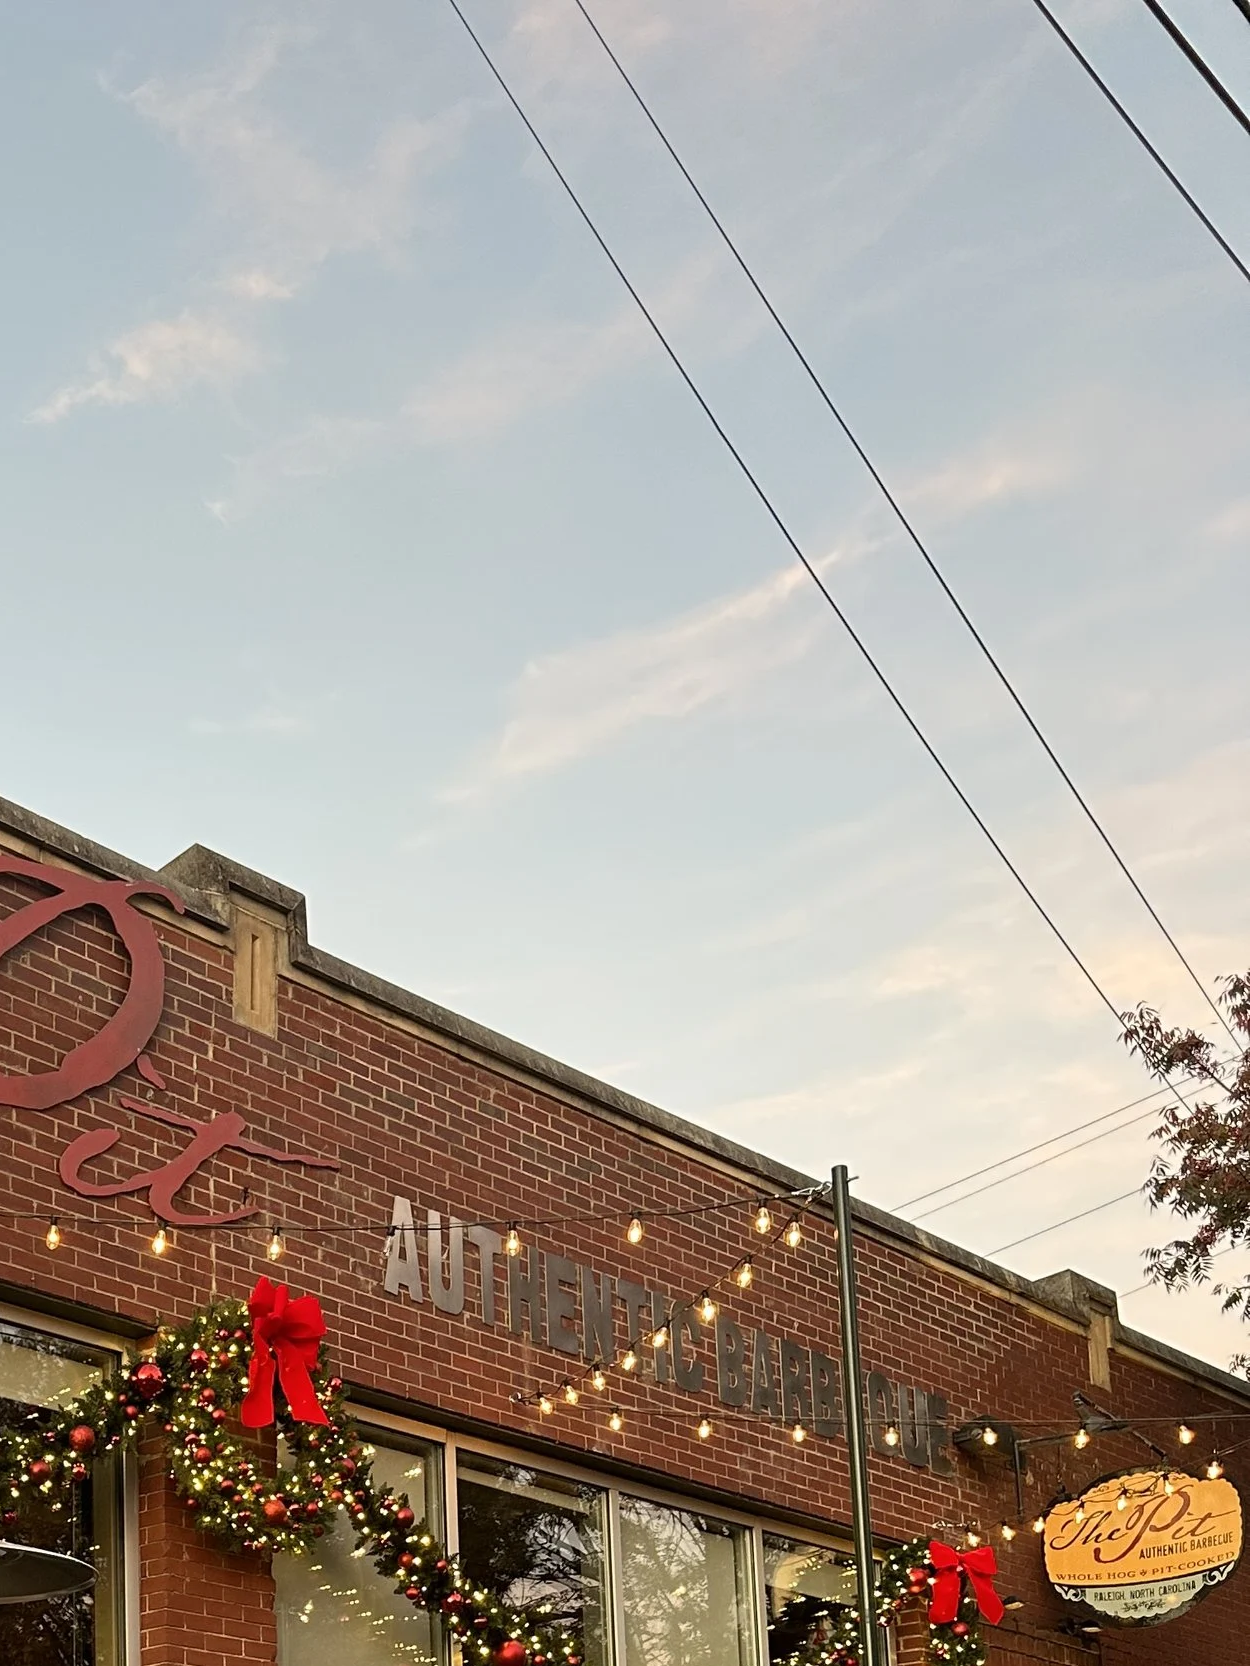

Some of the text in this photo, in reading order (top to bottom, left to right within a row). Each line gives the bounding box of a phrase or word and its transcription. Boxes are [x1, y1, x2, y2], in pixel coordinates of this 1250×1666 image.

[384, 1196, 954, 1478] AUTHENTIC BARBCUE
[1050, 1485, 1237, 1564] The Pit
[1139, 1531, 1233, 1560] AUTHENTIC BARBECUE
[1056, 1551, 1235, 1581] WHOLE HOG PIT-COOKED
[1130, 1587, 1155, 1600] NORTH
[1158, 1580, 1197, 1596] CAROLINA
